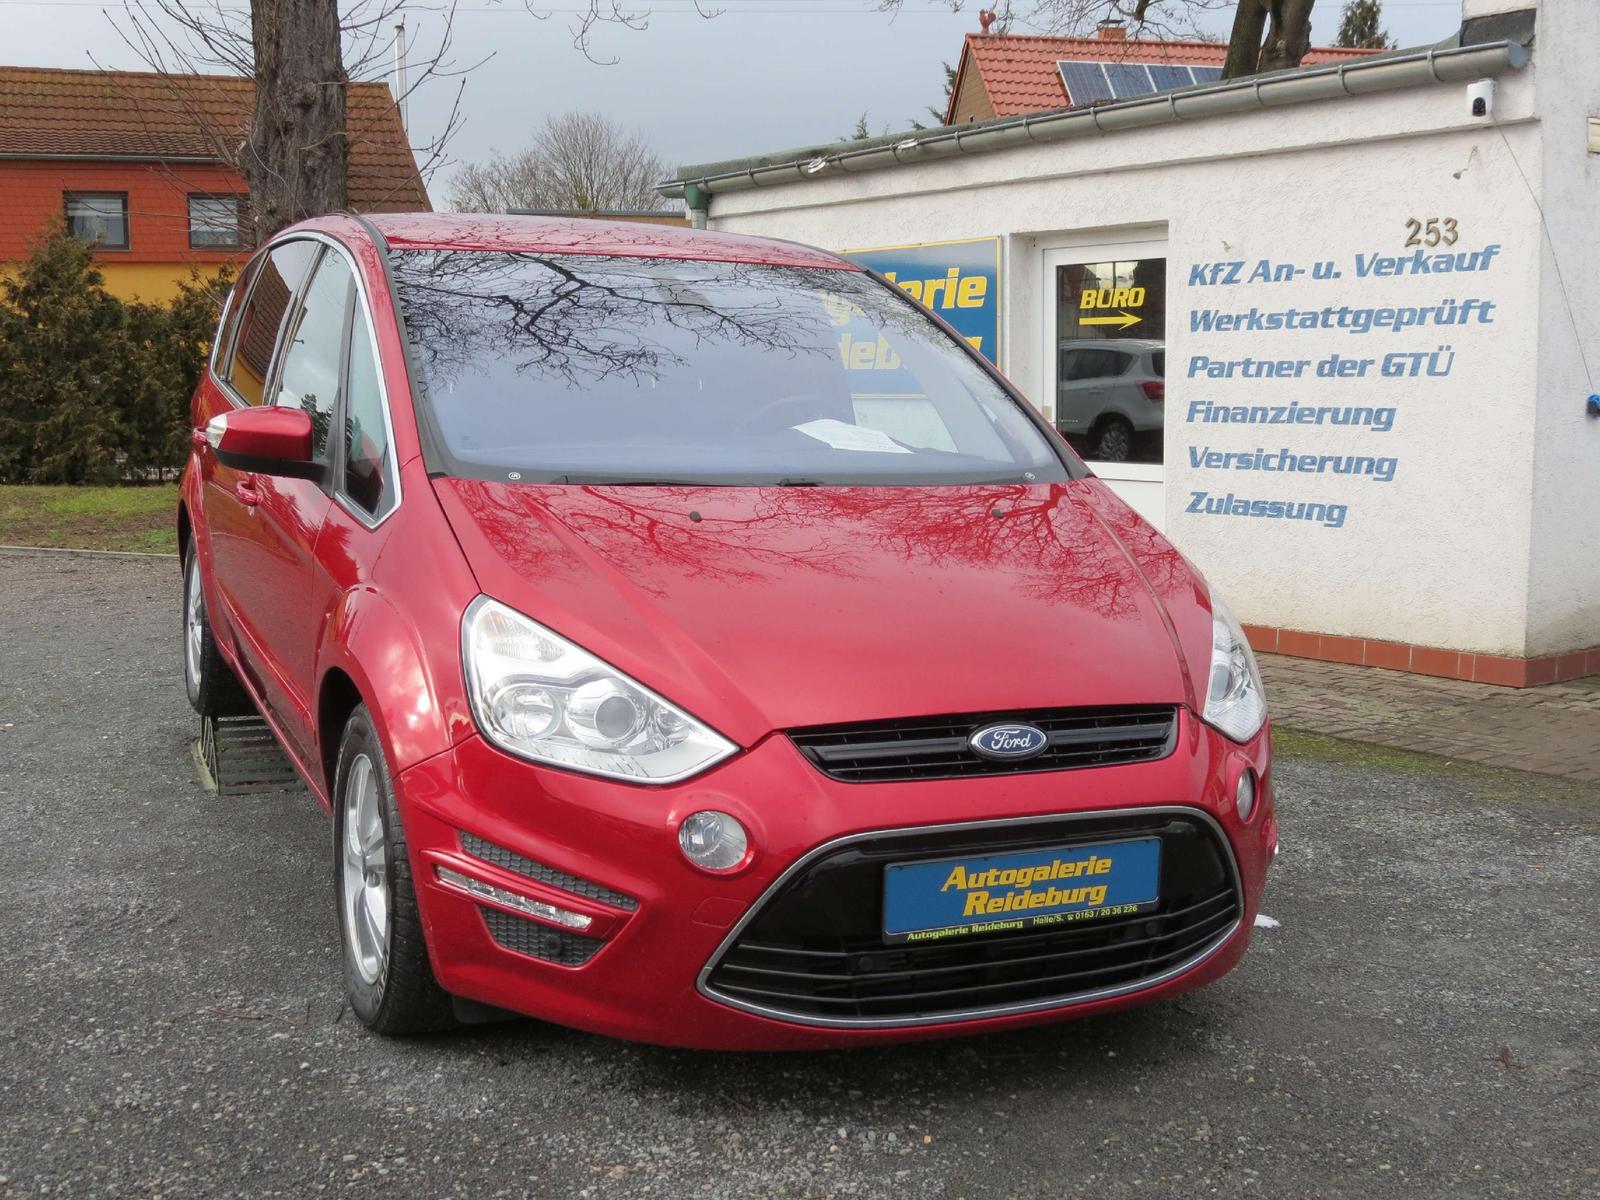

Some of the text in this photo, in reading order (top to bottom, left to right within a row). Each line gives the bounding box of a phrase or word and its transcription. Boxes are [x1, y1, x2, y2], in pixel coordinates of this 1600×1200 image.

[1404, 217, 1459, 247] 253
[1247, 259, 1306, 284] An-
[1311, 260, 1342, 280] u.
[1354, 244, 1502, 278] Verkauf
[1189, 298, 1497, 334] Werkstattgeprüft
[1187, 345, 1455, 378] Partner der GTÜ
[1185, 400, 1397, 432] Finanzierung
[1188, 446, 1398, 482] Versicherung
[1184, 491, 1348, 528] Zulassung
[991, 730, 1031, 750] Ford
[940, 855, 1112, 892] Autogalerie
[963, 885, 1108, 916] Reideburg
[907, 926, 969, 941] Autogalerie
[971, 920, 1024, 934] Reideburg
